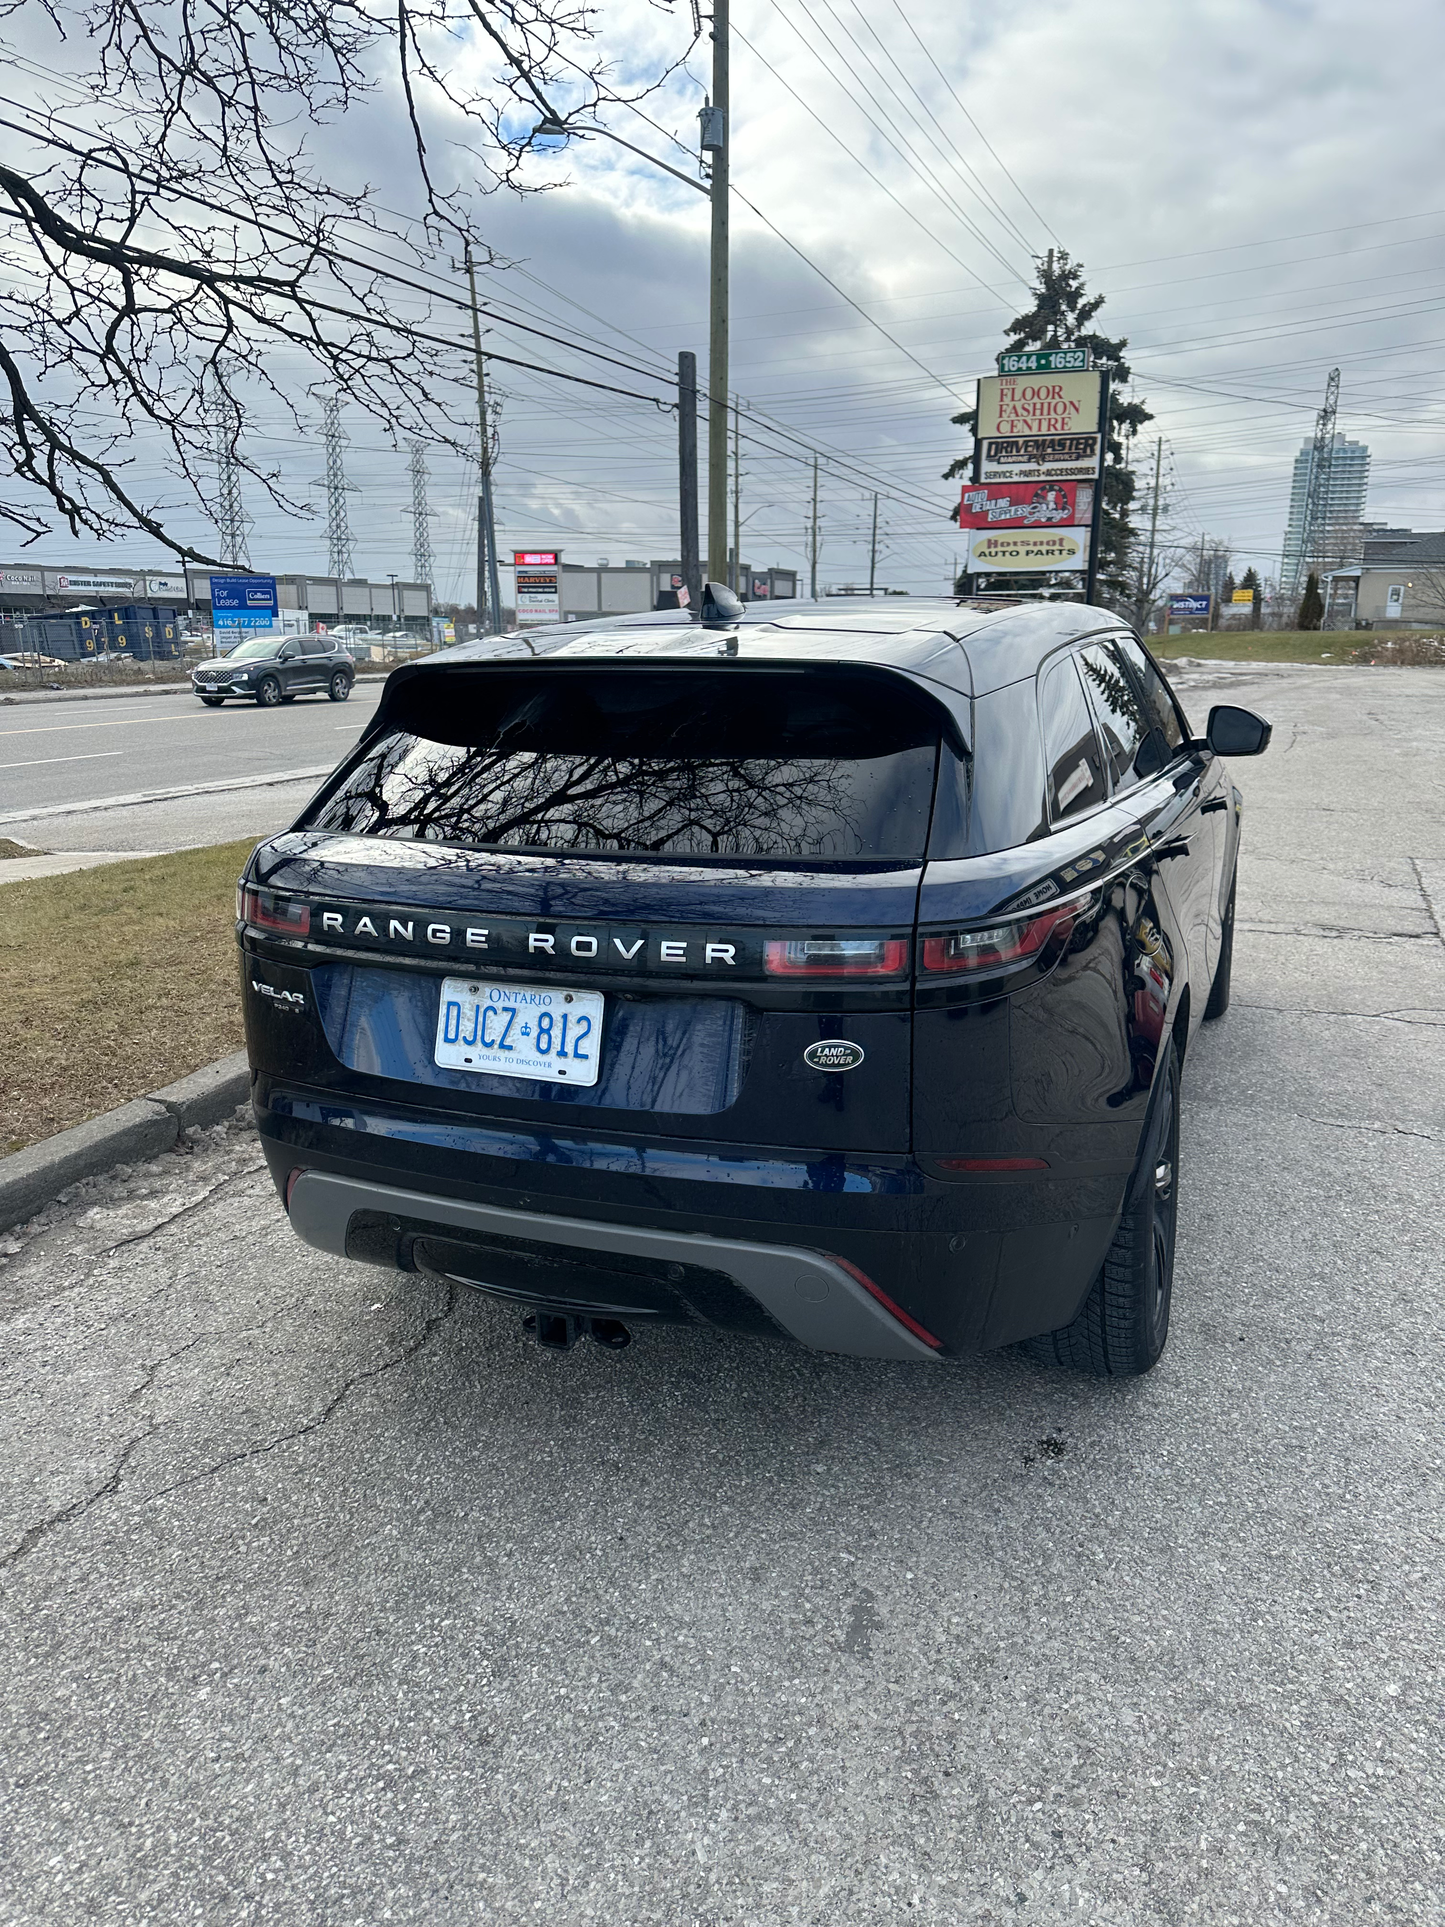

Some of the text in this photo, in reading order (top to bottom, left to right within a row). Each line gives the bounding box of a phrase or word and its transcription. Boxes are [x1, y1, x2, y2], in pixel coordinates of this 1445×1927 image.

[1002, 352, 1084, 371] 1644 1652
[999, 378, 1019, 386] THE
[999, 385, 1064, 403] FLOOR
[998, 400, 1082, 418] FASHION
[996, 417, 1072, 434] CENTRE
[986, 436, 1098, 459] DRIVEMASTER
[999, 453, 1078, 464] MARINE SERVICE
[984, 466, 1096, 479] SERVICE PARTS ACCESSORIES
[965, 491, 987, 503] AUTO
[973, 498, 1010, 511] DETAILING
[989, 505, 1028, 521] SUPPLIES
[977, 548, 1076, 558] AUTO PARTS
[215, 589, 229, 597] For
[216, 598, 239, 606] Lease
[218, 618, 232, 626] 416
[322, 911, 737, 966] RANGE ROVER
[252, 980, 305, 1004] VELAR
[489, 988, 552, 1007] ONTARIO
[443, 1001, 592, 1060] DJCZ 812
[816, 1047, 844, 1056] LAND
[477, 1053, 553, 1069] YOURS TO DISCOVER
[819, 1056, 854, 1065] ROVER
